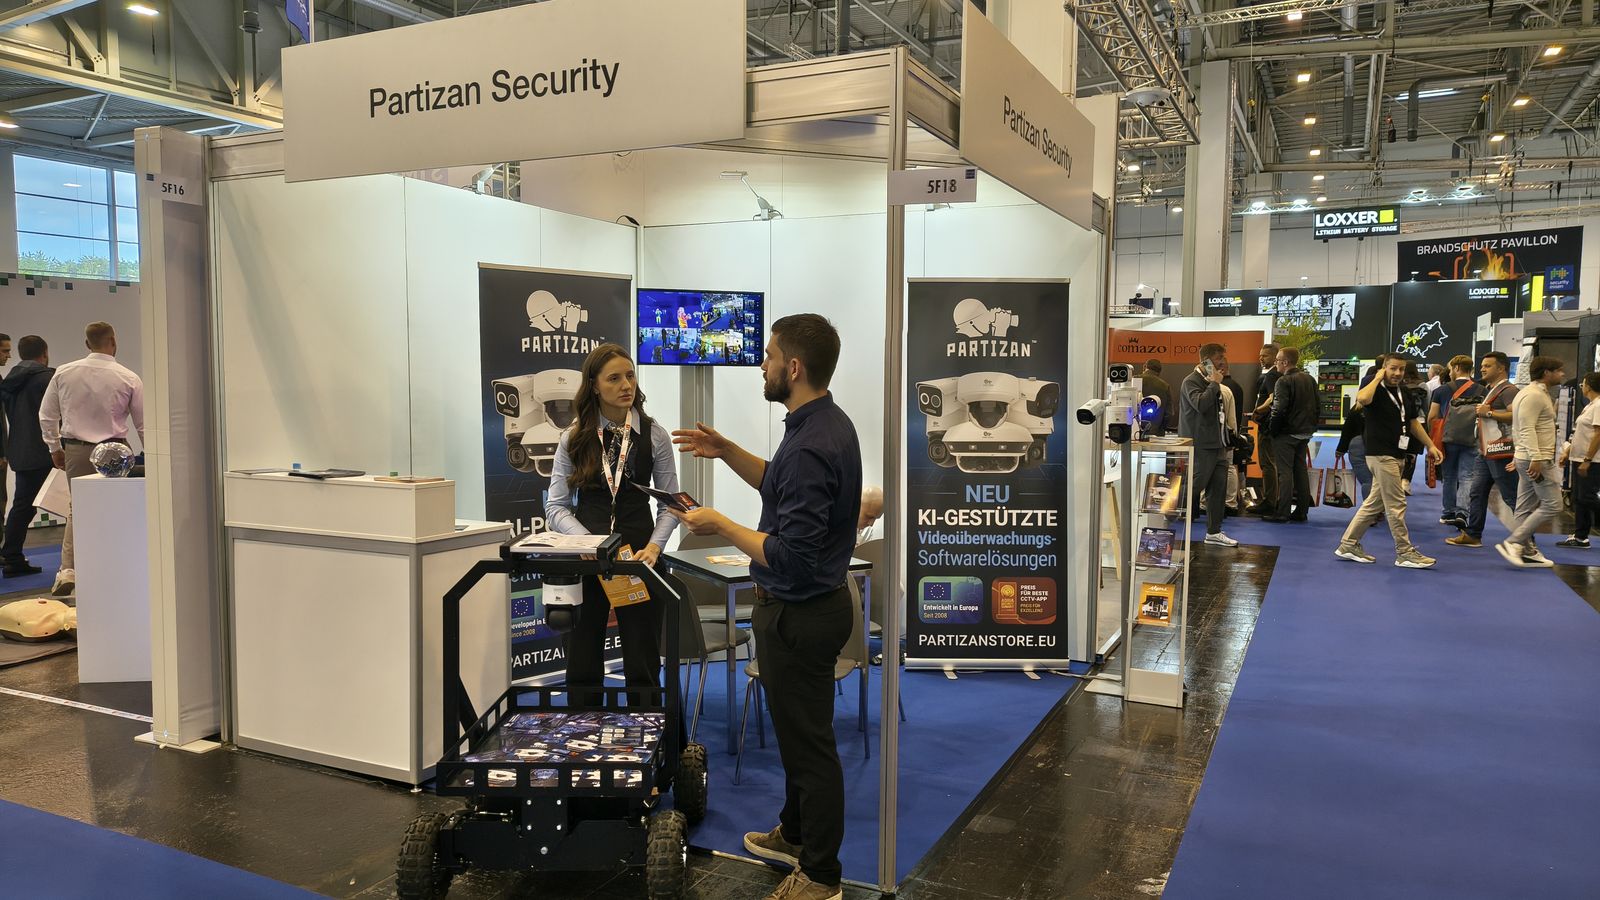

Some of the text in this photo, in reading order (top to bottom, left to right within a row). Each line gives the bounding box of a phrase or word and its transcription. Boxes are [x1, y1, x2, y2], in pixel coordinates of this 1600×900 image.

[369, 58, 620, 119] Partizan Security
[1003, 95, 1073, 179] Partizan Security
[161, 182, 185, 196] 5F16
[927, 179, 957, 194] 5F18
[1315, 211, 1378, 227] LOXXER
[1417, 234, 1558, 255] BRANDSCHUTZ PAVILLON
[1468, 287, 1500, 296] LOXXER
[946, 339, 1031, 357] PARTIZAN
[965, 484, 1010, 503] NEU
[917, 506, 1058, 527] KI-GESTÜTZTE
[917, 531, 1057, 548] Videoüberwachungs-
[918, 550, 1057, 570] Softwarelösungen
[511, 619, 536, 629] eveloped
[918, 635, 1056, 647] PARTIZANSTORE.EU
